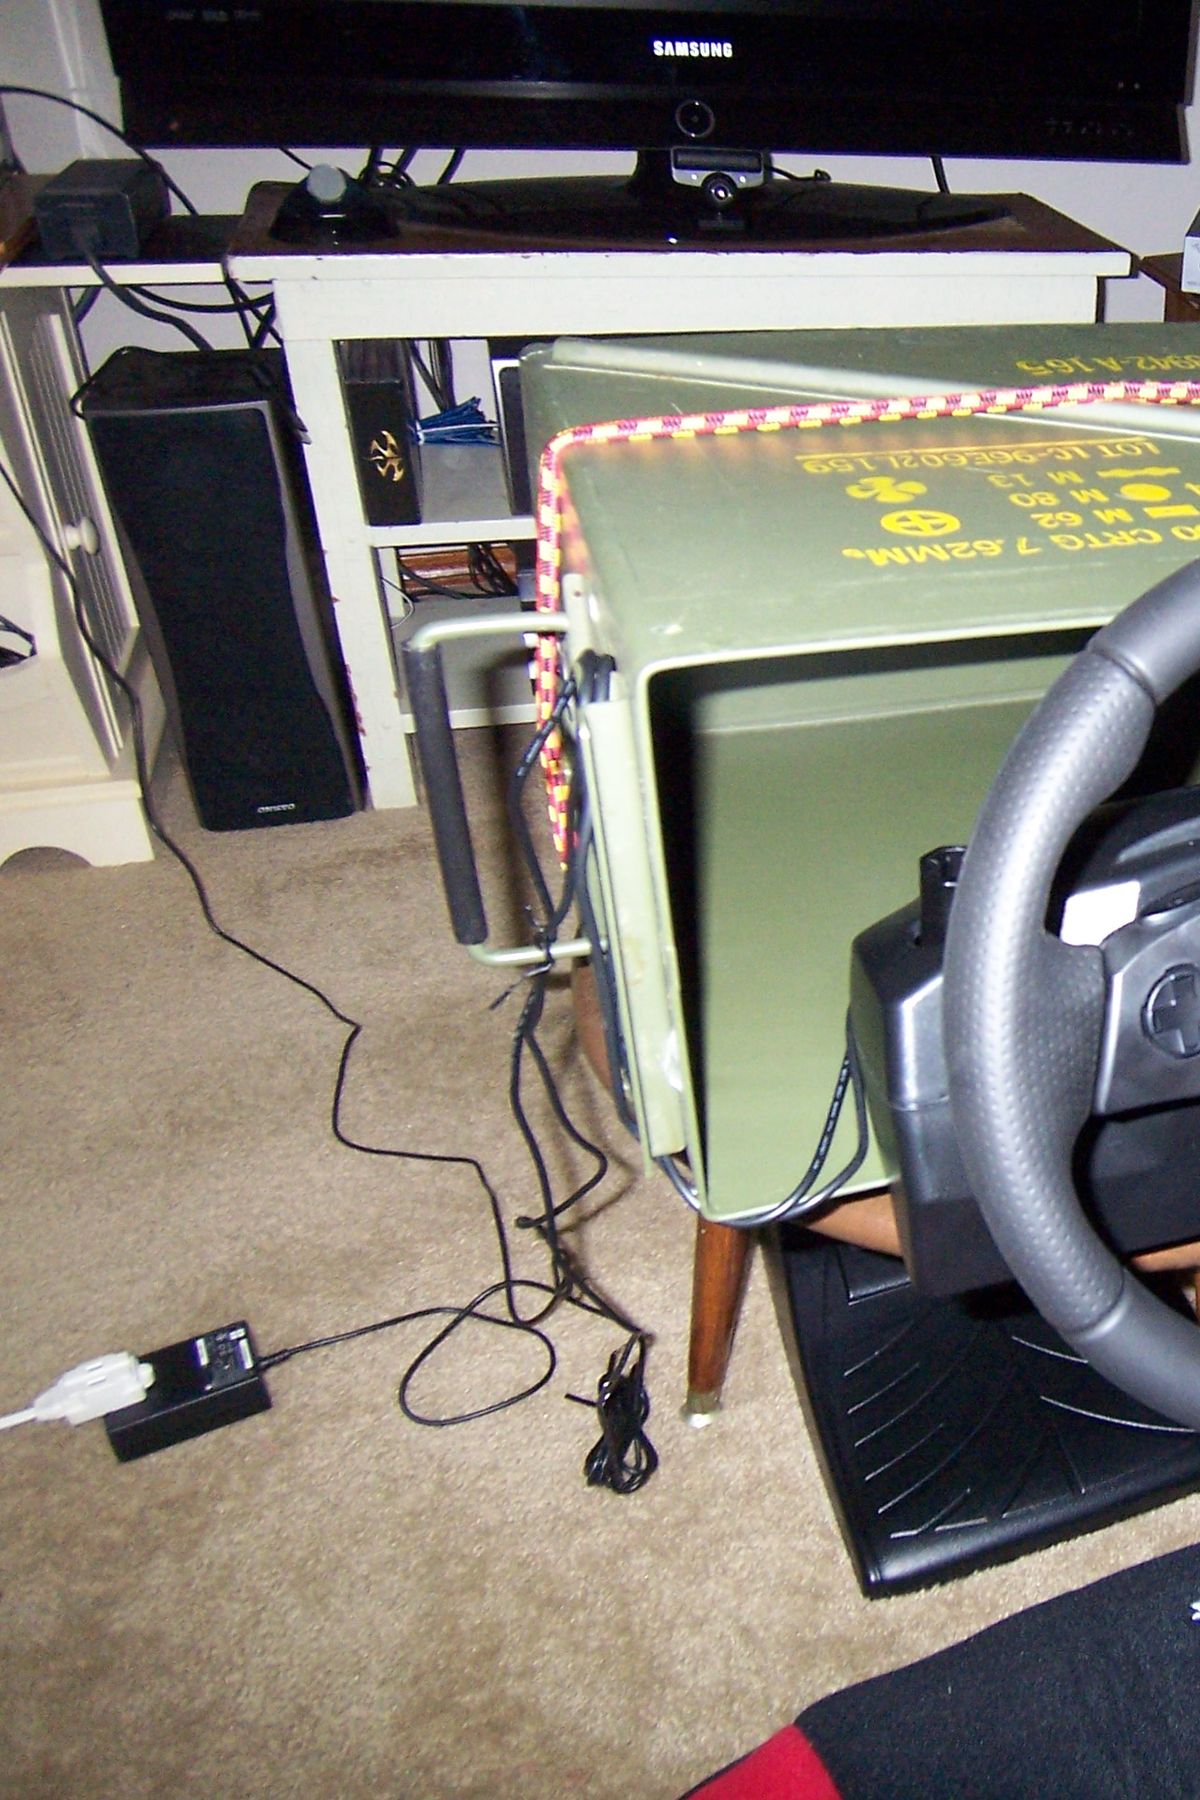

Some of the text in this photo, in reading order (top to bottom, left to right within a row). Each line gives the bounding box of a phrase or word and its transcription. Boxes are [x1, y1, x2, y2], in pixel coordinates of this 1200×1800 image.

[653, 40, 733, 58] SAMSUNG
[987, 470, 1084, 488] M 13
[1009, 490, 1060, 508] 80
[1069, 488, 1109, 504] M
[1030, 511, 1083, 528] 62
[1092, 508, 1133, 524] M
[1049, 528, 1163, 550] CRTG
